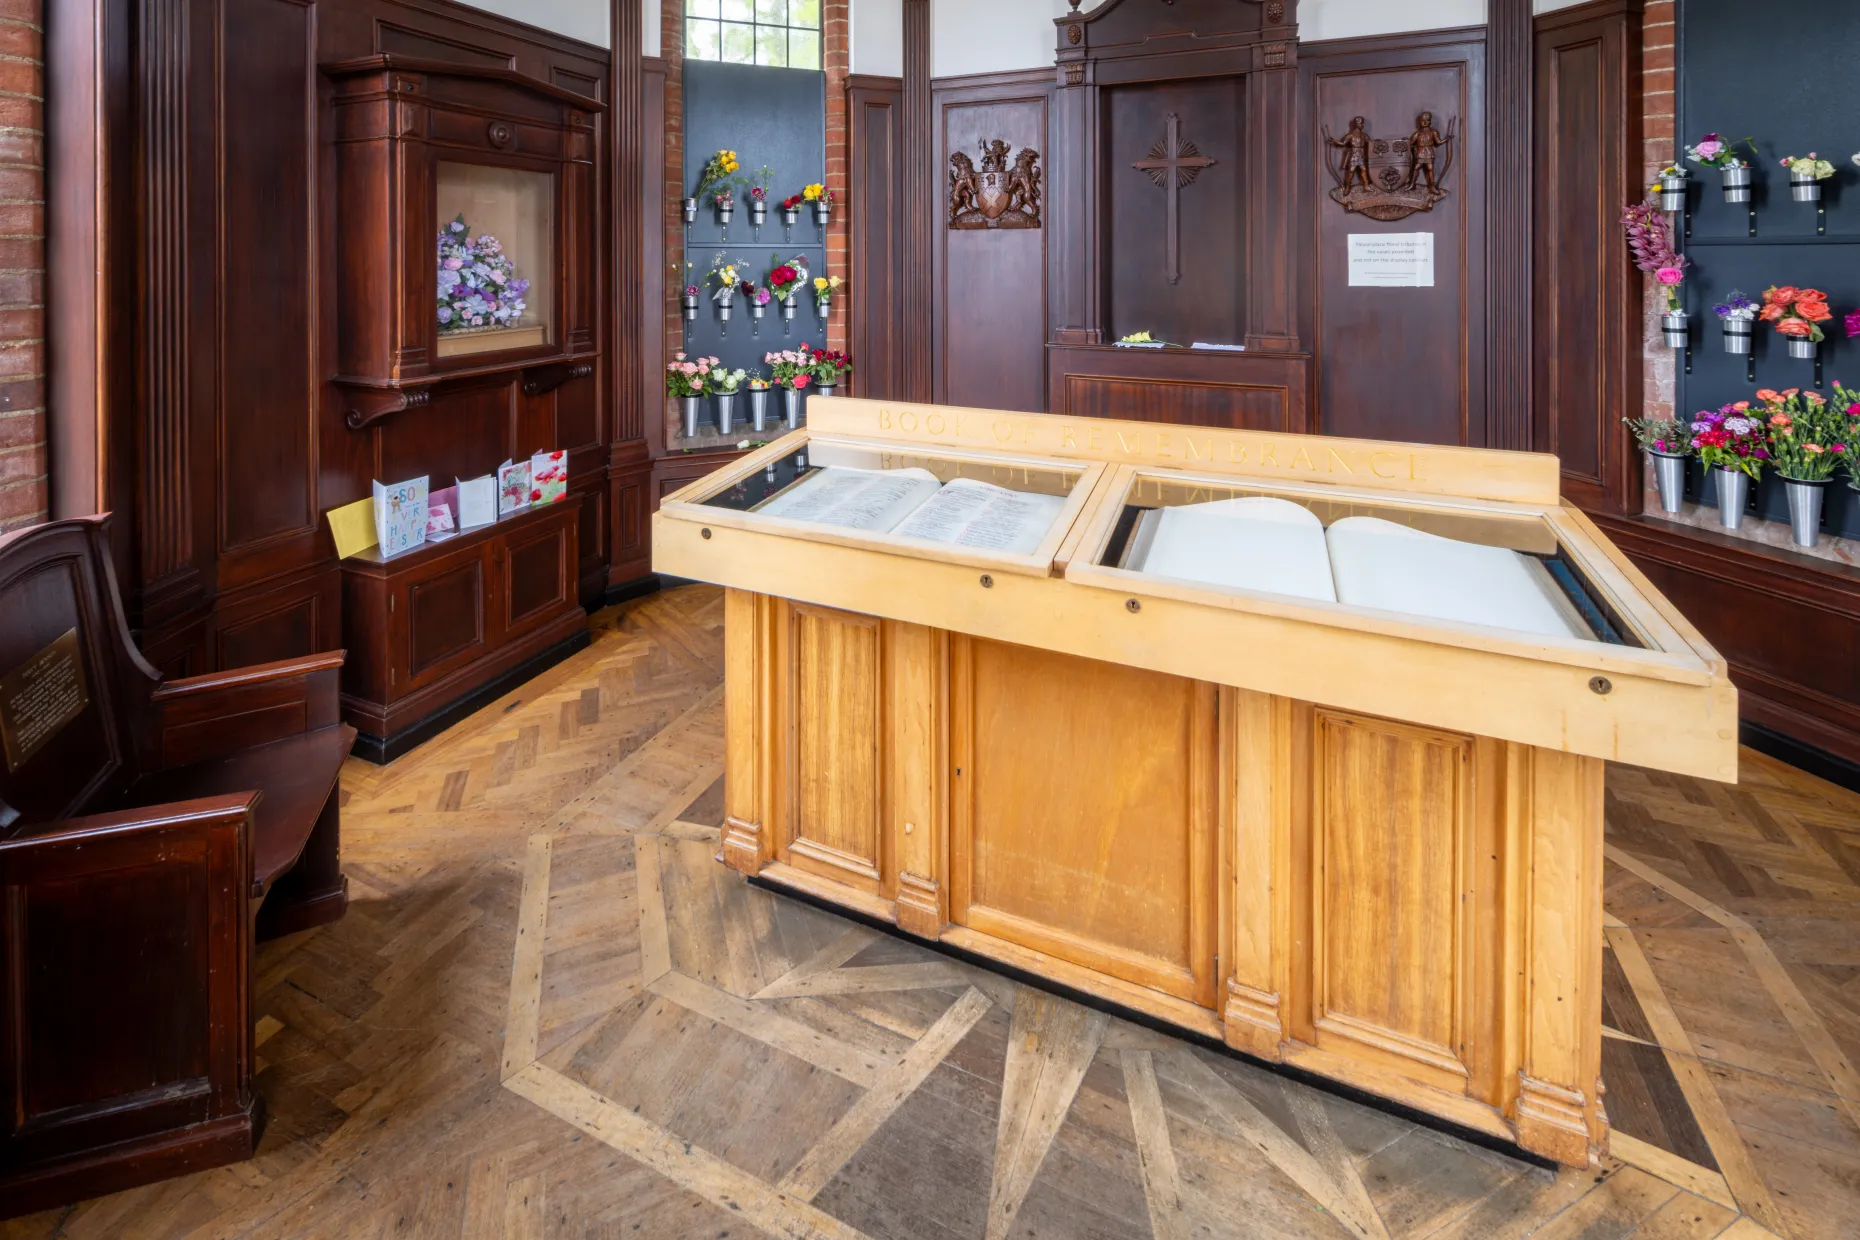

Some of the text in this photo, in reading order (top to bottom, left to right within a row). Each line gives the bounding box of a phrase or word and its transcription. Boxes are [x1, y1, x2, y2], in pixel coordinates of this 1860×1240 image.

[879, 409, 973, 439] BOOK
[992, 419, 1036, 444] OF
[1061, 424, 1427, 481] REMEMBRANCE
[399, 485, 425, 503] SON
